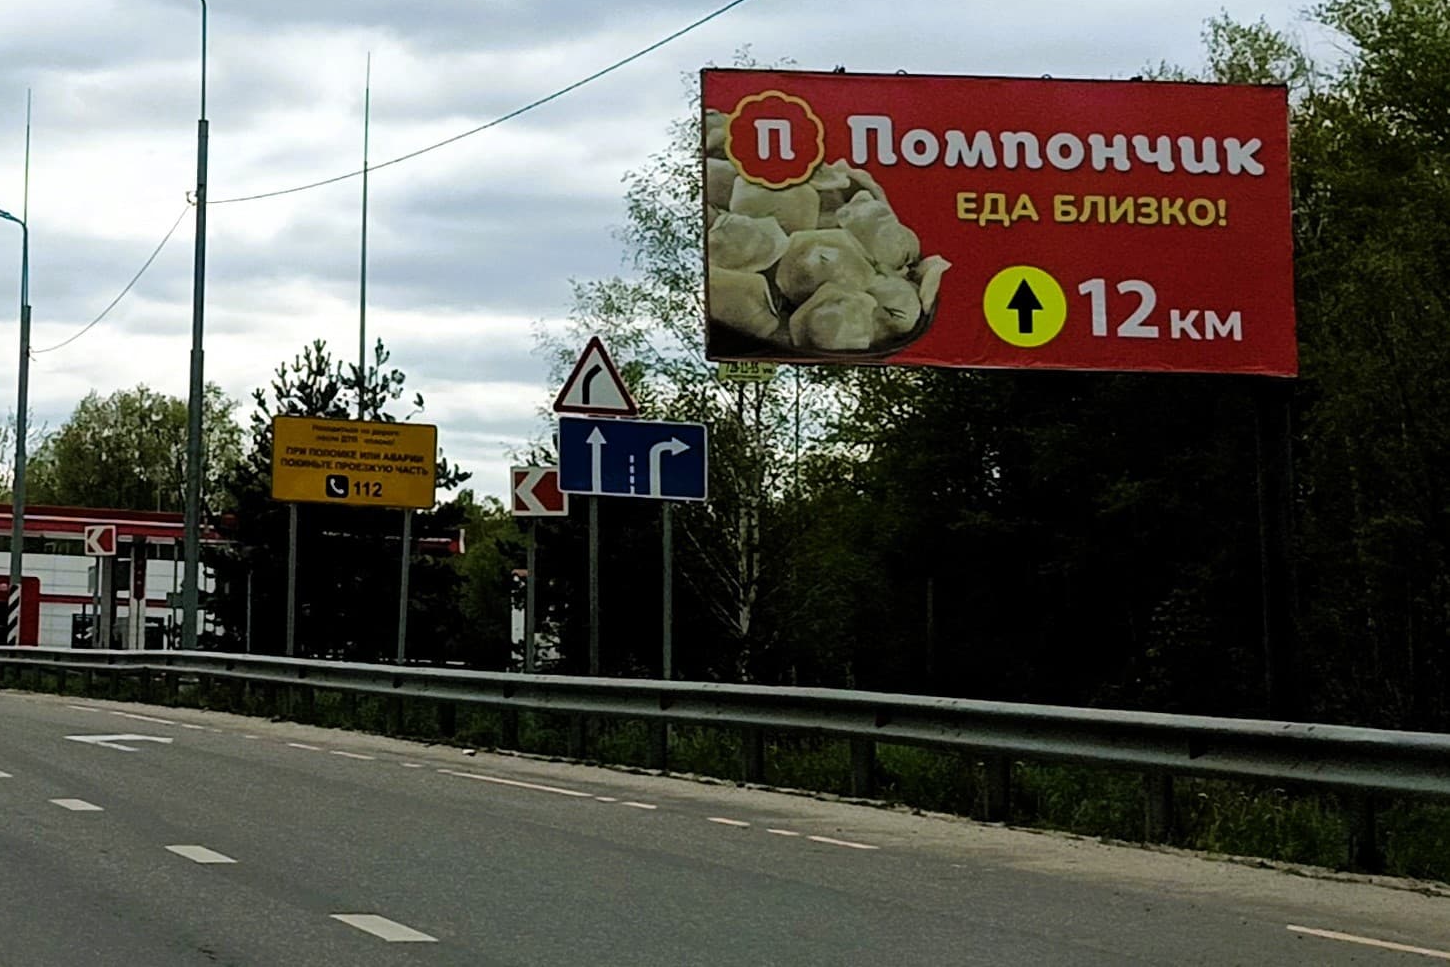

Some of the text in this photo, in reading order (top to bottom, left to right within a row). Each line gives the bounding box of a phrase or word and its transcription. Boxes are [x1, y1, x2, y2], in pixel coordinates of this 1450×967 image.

[753, 119, 795, 161] П
[846, 115, 1265, 176] Помпончик
[956, 192, 1227, 227] ЕДА БЛИЗКО!
[1078, 278, 1159, 338] 12
[353, 482, 382, 498] 112
